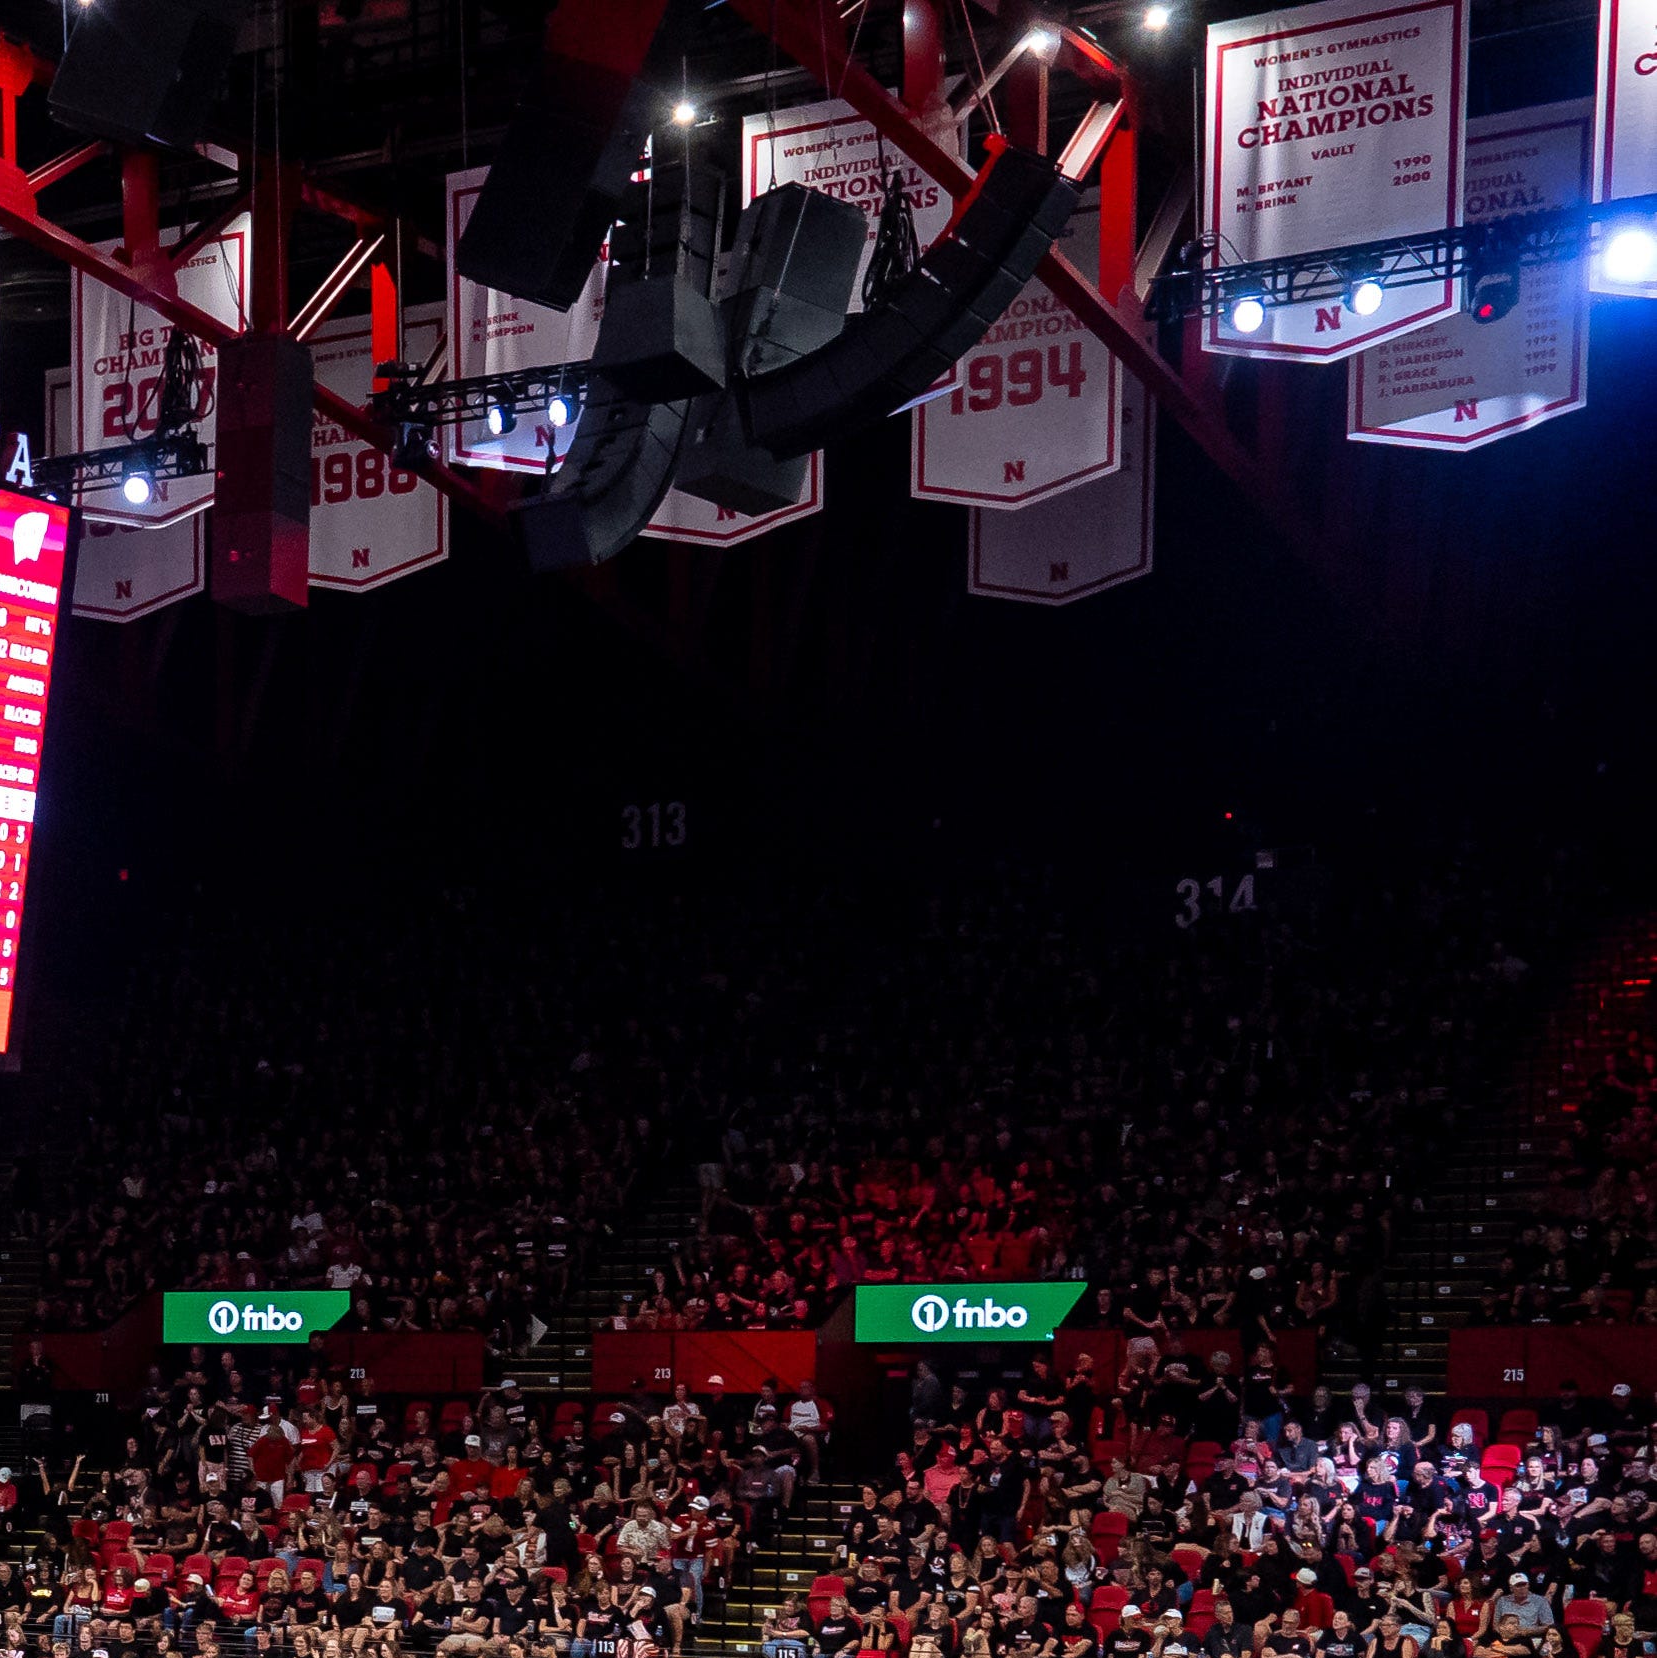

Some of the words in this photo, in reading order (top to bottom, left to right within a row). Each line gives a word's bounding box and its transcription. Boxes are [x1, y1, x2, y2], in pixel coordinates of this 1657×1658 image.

[1254, 46, 1323, 68] WOMEN'S
[1327, 27, 1421, 54] GYMNASTICS
[1277, 59, 1394, 92] INDIVIDUAL
[1257, 74, 1415, 121] NATIONAL
[1238, 94, 1434, 149] CHAMPIONS
[784, 140, 843, 157] WOMEN'S
[1312, 143, 1357, 160] VAULT
[1258, 176, 1313, 195] BRYANT
[1392, 154, 1432, 170] 1990
[1255, 194, 1298, 212] BRINK
[1391, 171, 1431, 187] 2000
[1315, 305, 1341, 333] N
[1454, 397, 1479, 423] N
[1004, 460, 1026, 483] N
[351, 547, 371, 569] N
[116, 579, 133, 600] N
[1176, 875, 1256, 928] 314
[242, 1305, 302, 1330] fnbo
[953, 1299, 1027, 1327] fnbo
[1504, 1369, 1523, 1381] 215
[598, 1641, 614, 1653] 113
